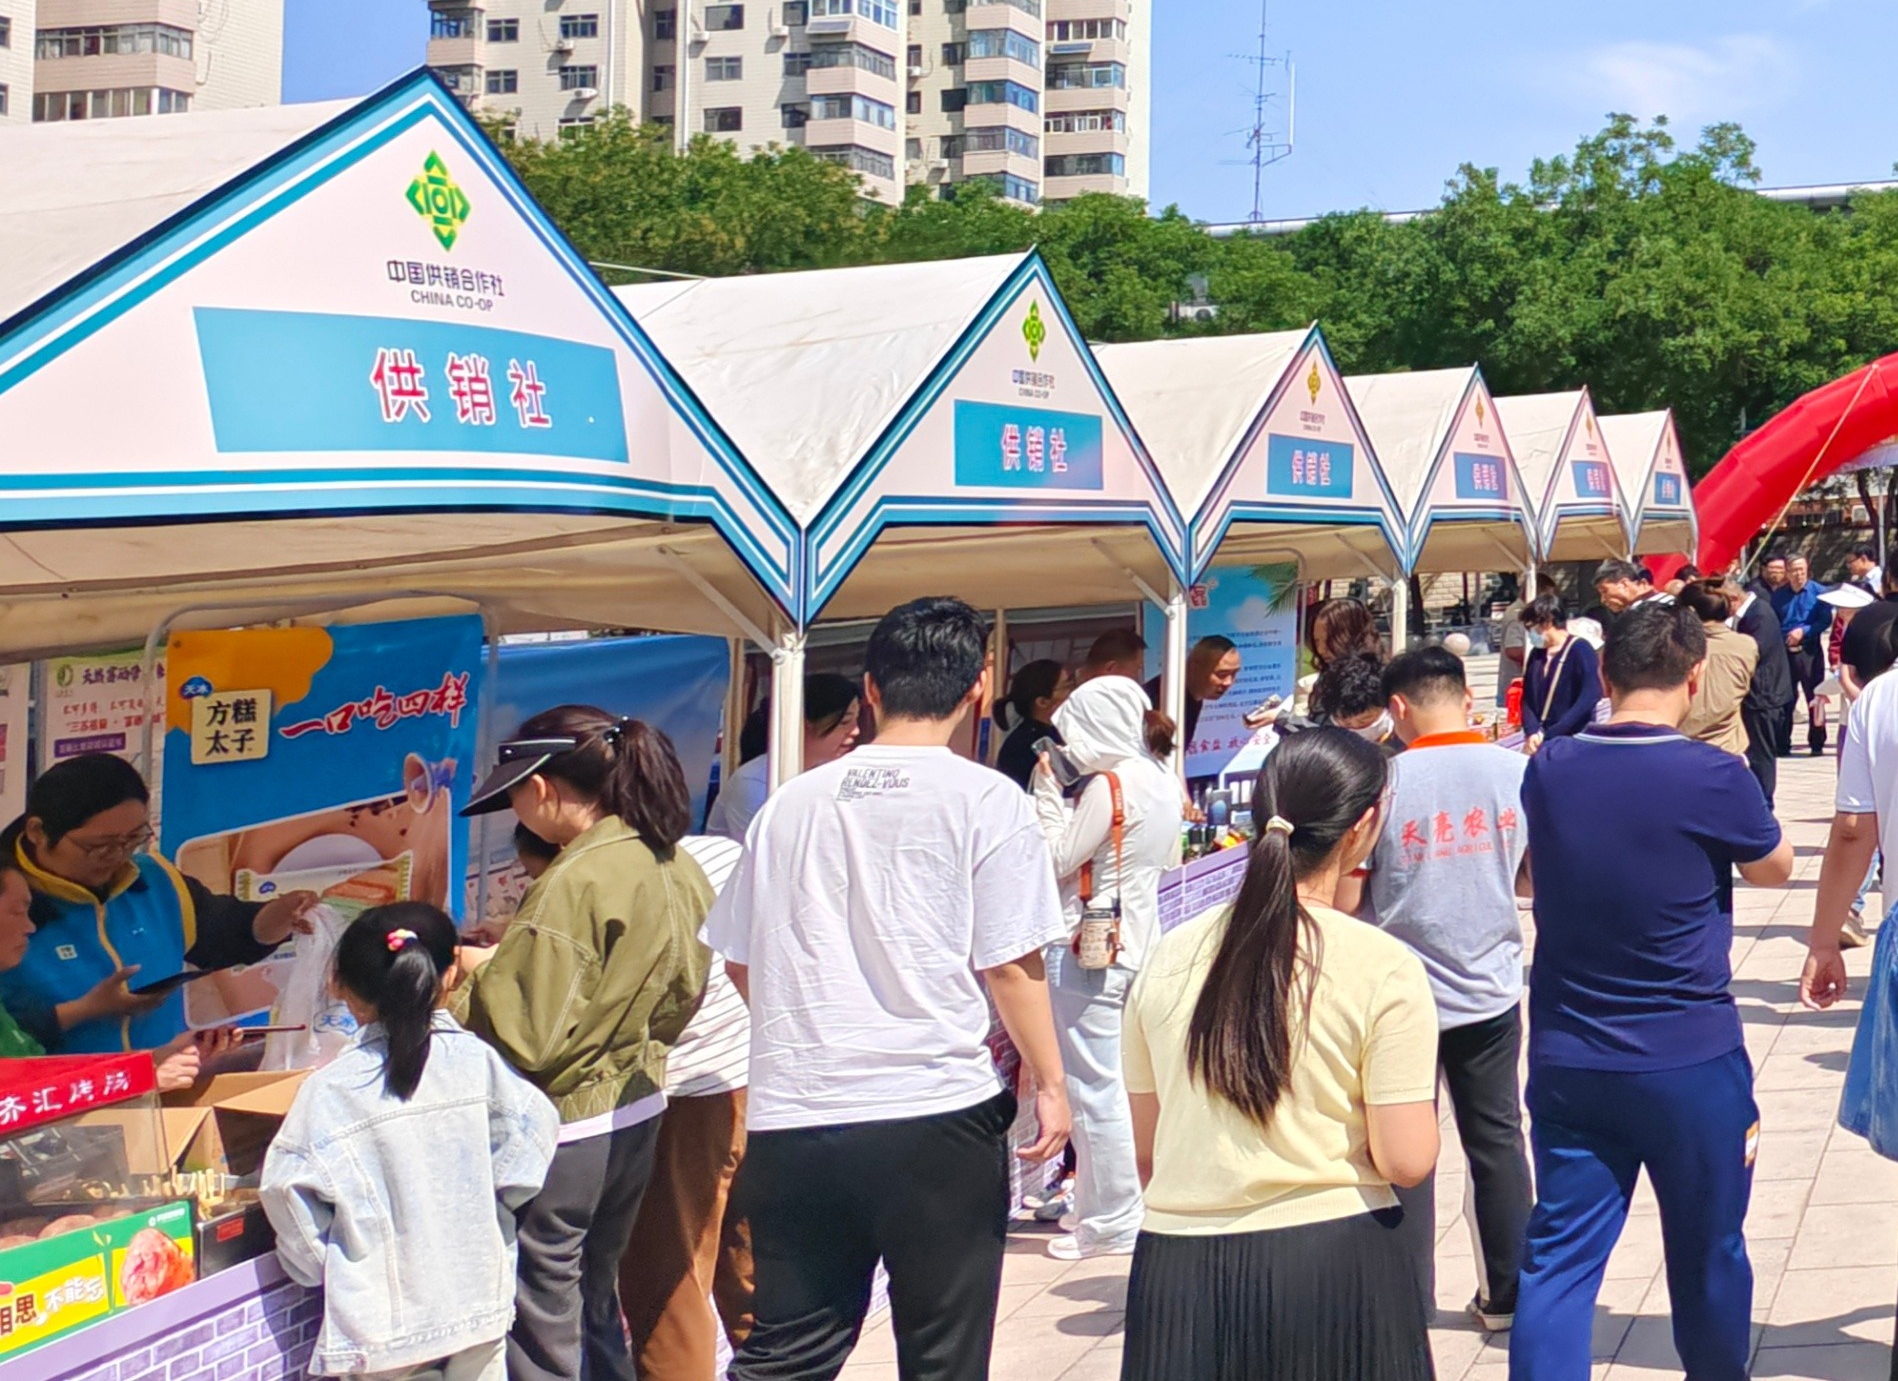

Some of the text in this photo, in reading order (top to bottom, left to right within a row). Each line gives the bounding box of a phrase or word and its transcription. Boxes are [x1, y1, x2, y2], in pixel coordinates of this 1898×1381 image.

[387, 260, 505, 297] 中国供销合作社
[411, 290, 494, 312] CHINA CO-OP
[371, 348, 552, 427] 供销社
[1001, 423, 1067, 473] 供销社
[206, 697, 258, 726] 方糕
[278, 671, 470, 739] 一口吃四样
[205, 728, 256, 756] 太子
